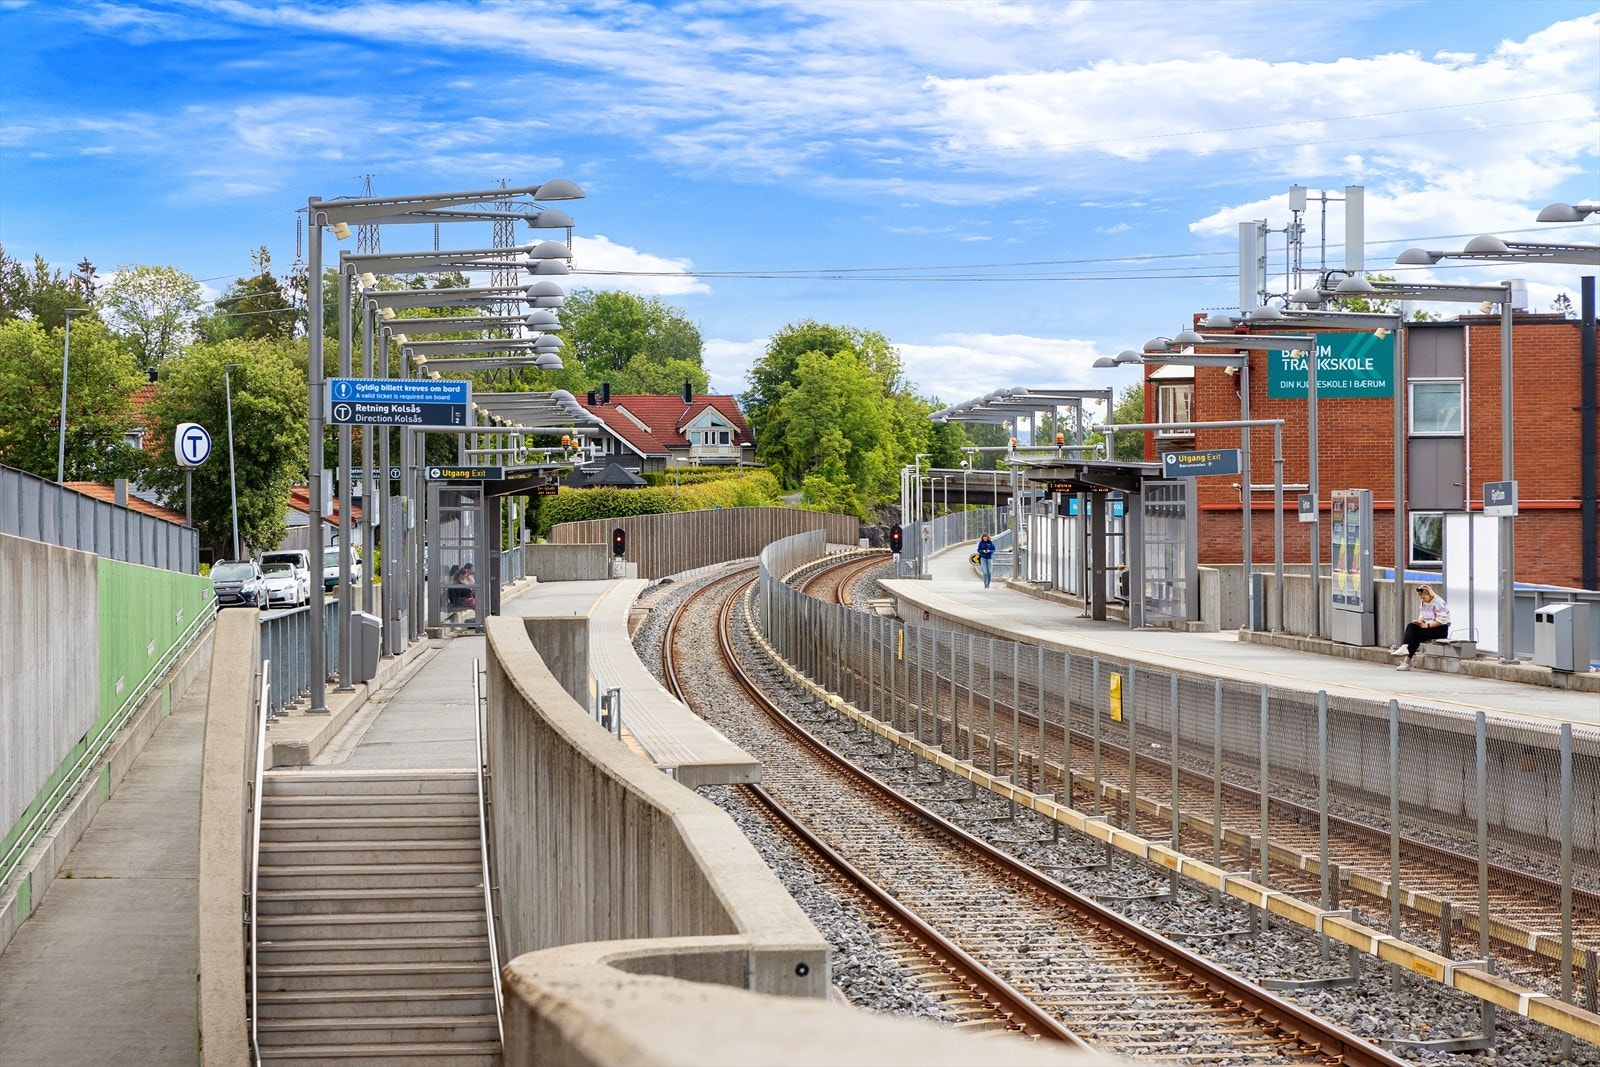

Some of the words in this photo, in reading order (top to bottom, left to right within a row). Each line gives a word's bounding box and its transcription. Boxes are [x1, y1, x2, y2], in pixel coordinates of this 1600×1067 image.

[355, 383, 379, 392] Gyldig
[443, 385, 460, 393] bord
[1280, 380, 1294, 389] DIN
[1296, 380, 1347, 388] KJESKOLE
[1354, 380, 1386, 388] BÆRUM
[355, 404, 389, 414] Retning
[391, 404, 421, 413] Kolsås
[355, 414, 392, 422] Direction
[394, 414, 423, 423] Kolsås
[1178, 454, 1206, 463] Utgang
[1207, 453, 1221, 461] Exit
[442, 469, 470, 478] Utgang
[471, 469, 487, 477] Exit
